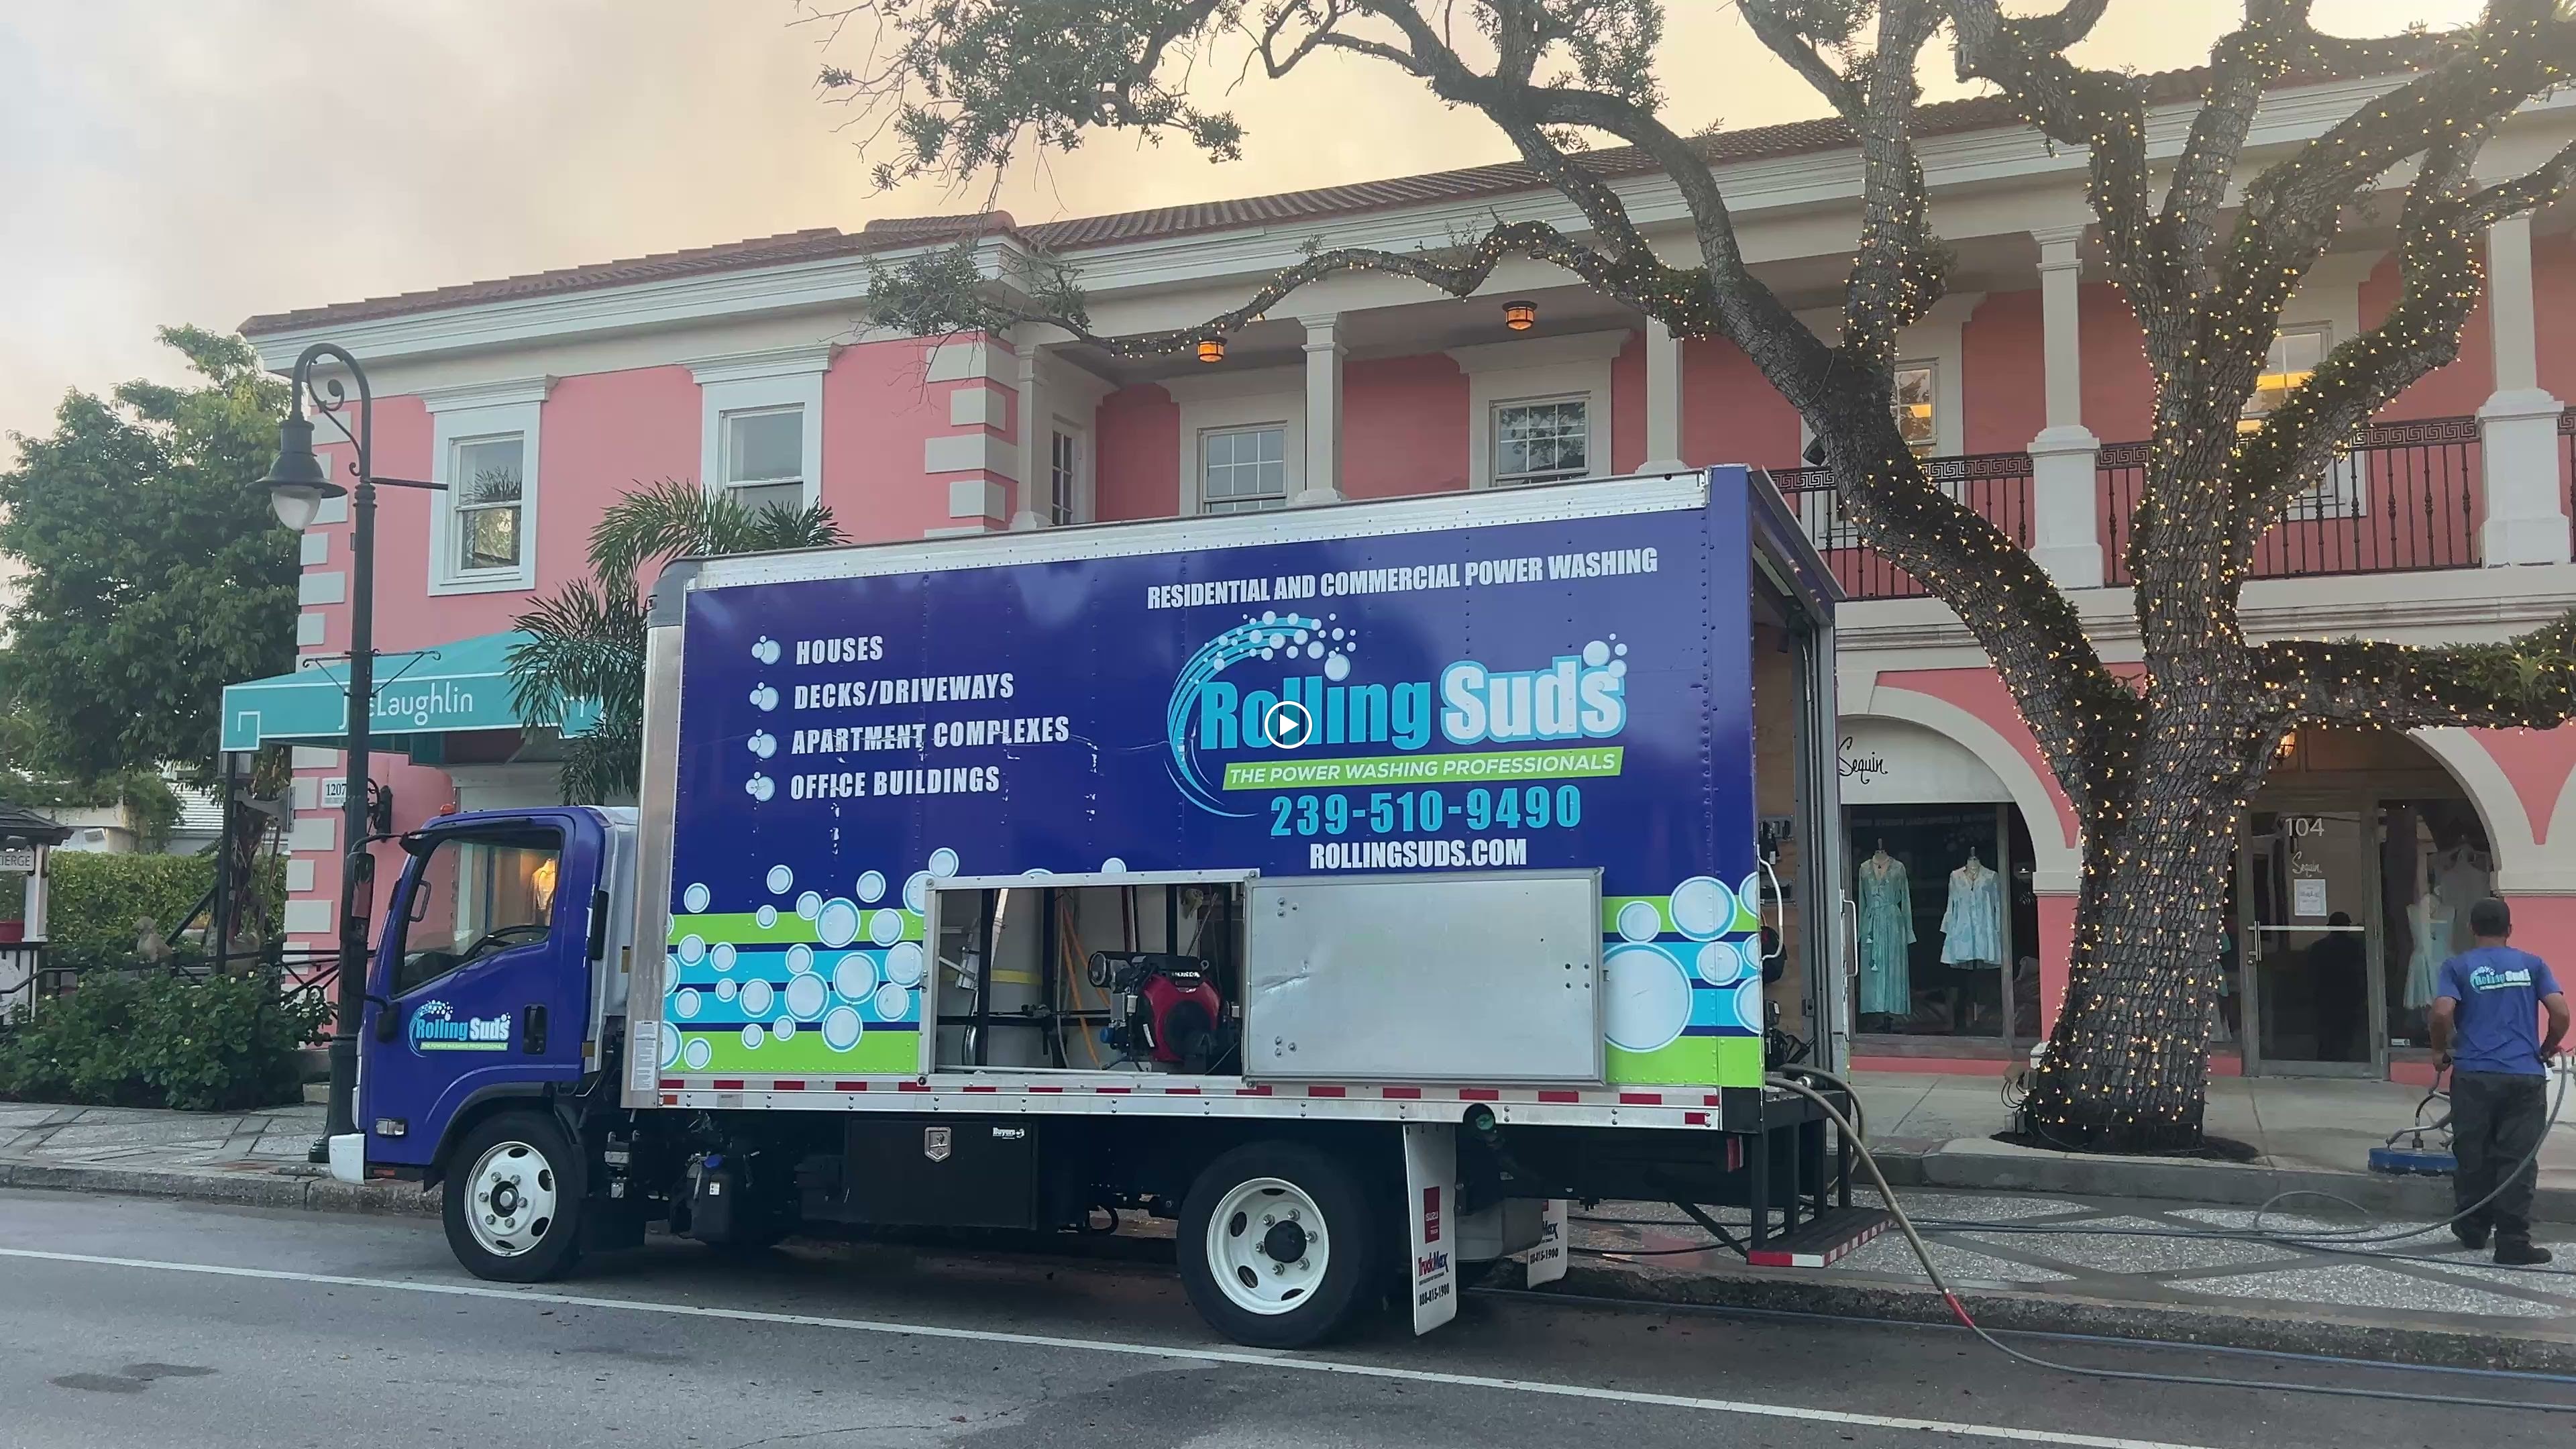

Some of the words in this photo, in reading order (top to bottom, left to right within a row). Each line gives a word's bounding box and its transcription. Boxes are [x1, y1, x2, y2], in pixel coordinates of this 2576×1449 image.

[1147, 578, 1271, 609] RESIDENTIAL
[1273, 575, 1316, 601] AND
[1320, 564, 1460, 597] COMMERCIAL
[1465, 557, 1543, 586] POWER
[1547, 547, 1658, 580] WASHING
[796, 635, 883, 665] HOUSES
[794, 673, 1014, 710] DECKS/DRIVEWAYS
[1200, 657, 1431, 751] Rolling
[1440, 655, 1627, 745] Suds
[791, 723, 926, 754] APARTMENT
[933, 716, 1069, 747] COMPLEXES
[1230, 768, 1266, 784] THE
[1269, 765, 1340, 782] POWER
[1345, 761, 1438, 779] WASHING
[1443, 753, 1615, 775] PROFESSIONALS
[1838, 736, 1888, 785] Sequin
[790, 772, 866, 800] OFFICE
[873, 766, 1000, 796] BUILDINGS
[1270, 785, 1581, 837] 239-510-9490
[2286, 818, 2324, 837] 104
[0, 855, 30, 866] IERGE
[1310, 839, 1527, 869] ROLLINGSUDS.COM
[416, 1014, 468, 1041] Rolling
[470, 1016, 510, 1040] Suds
